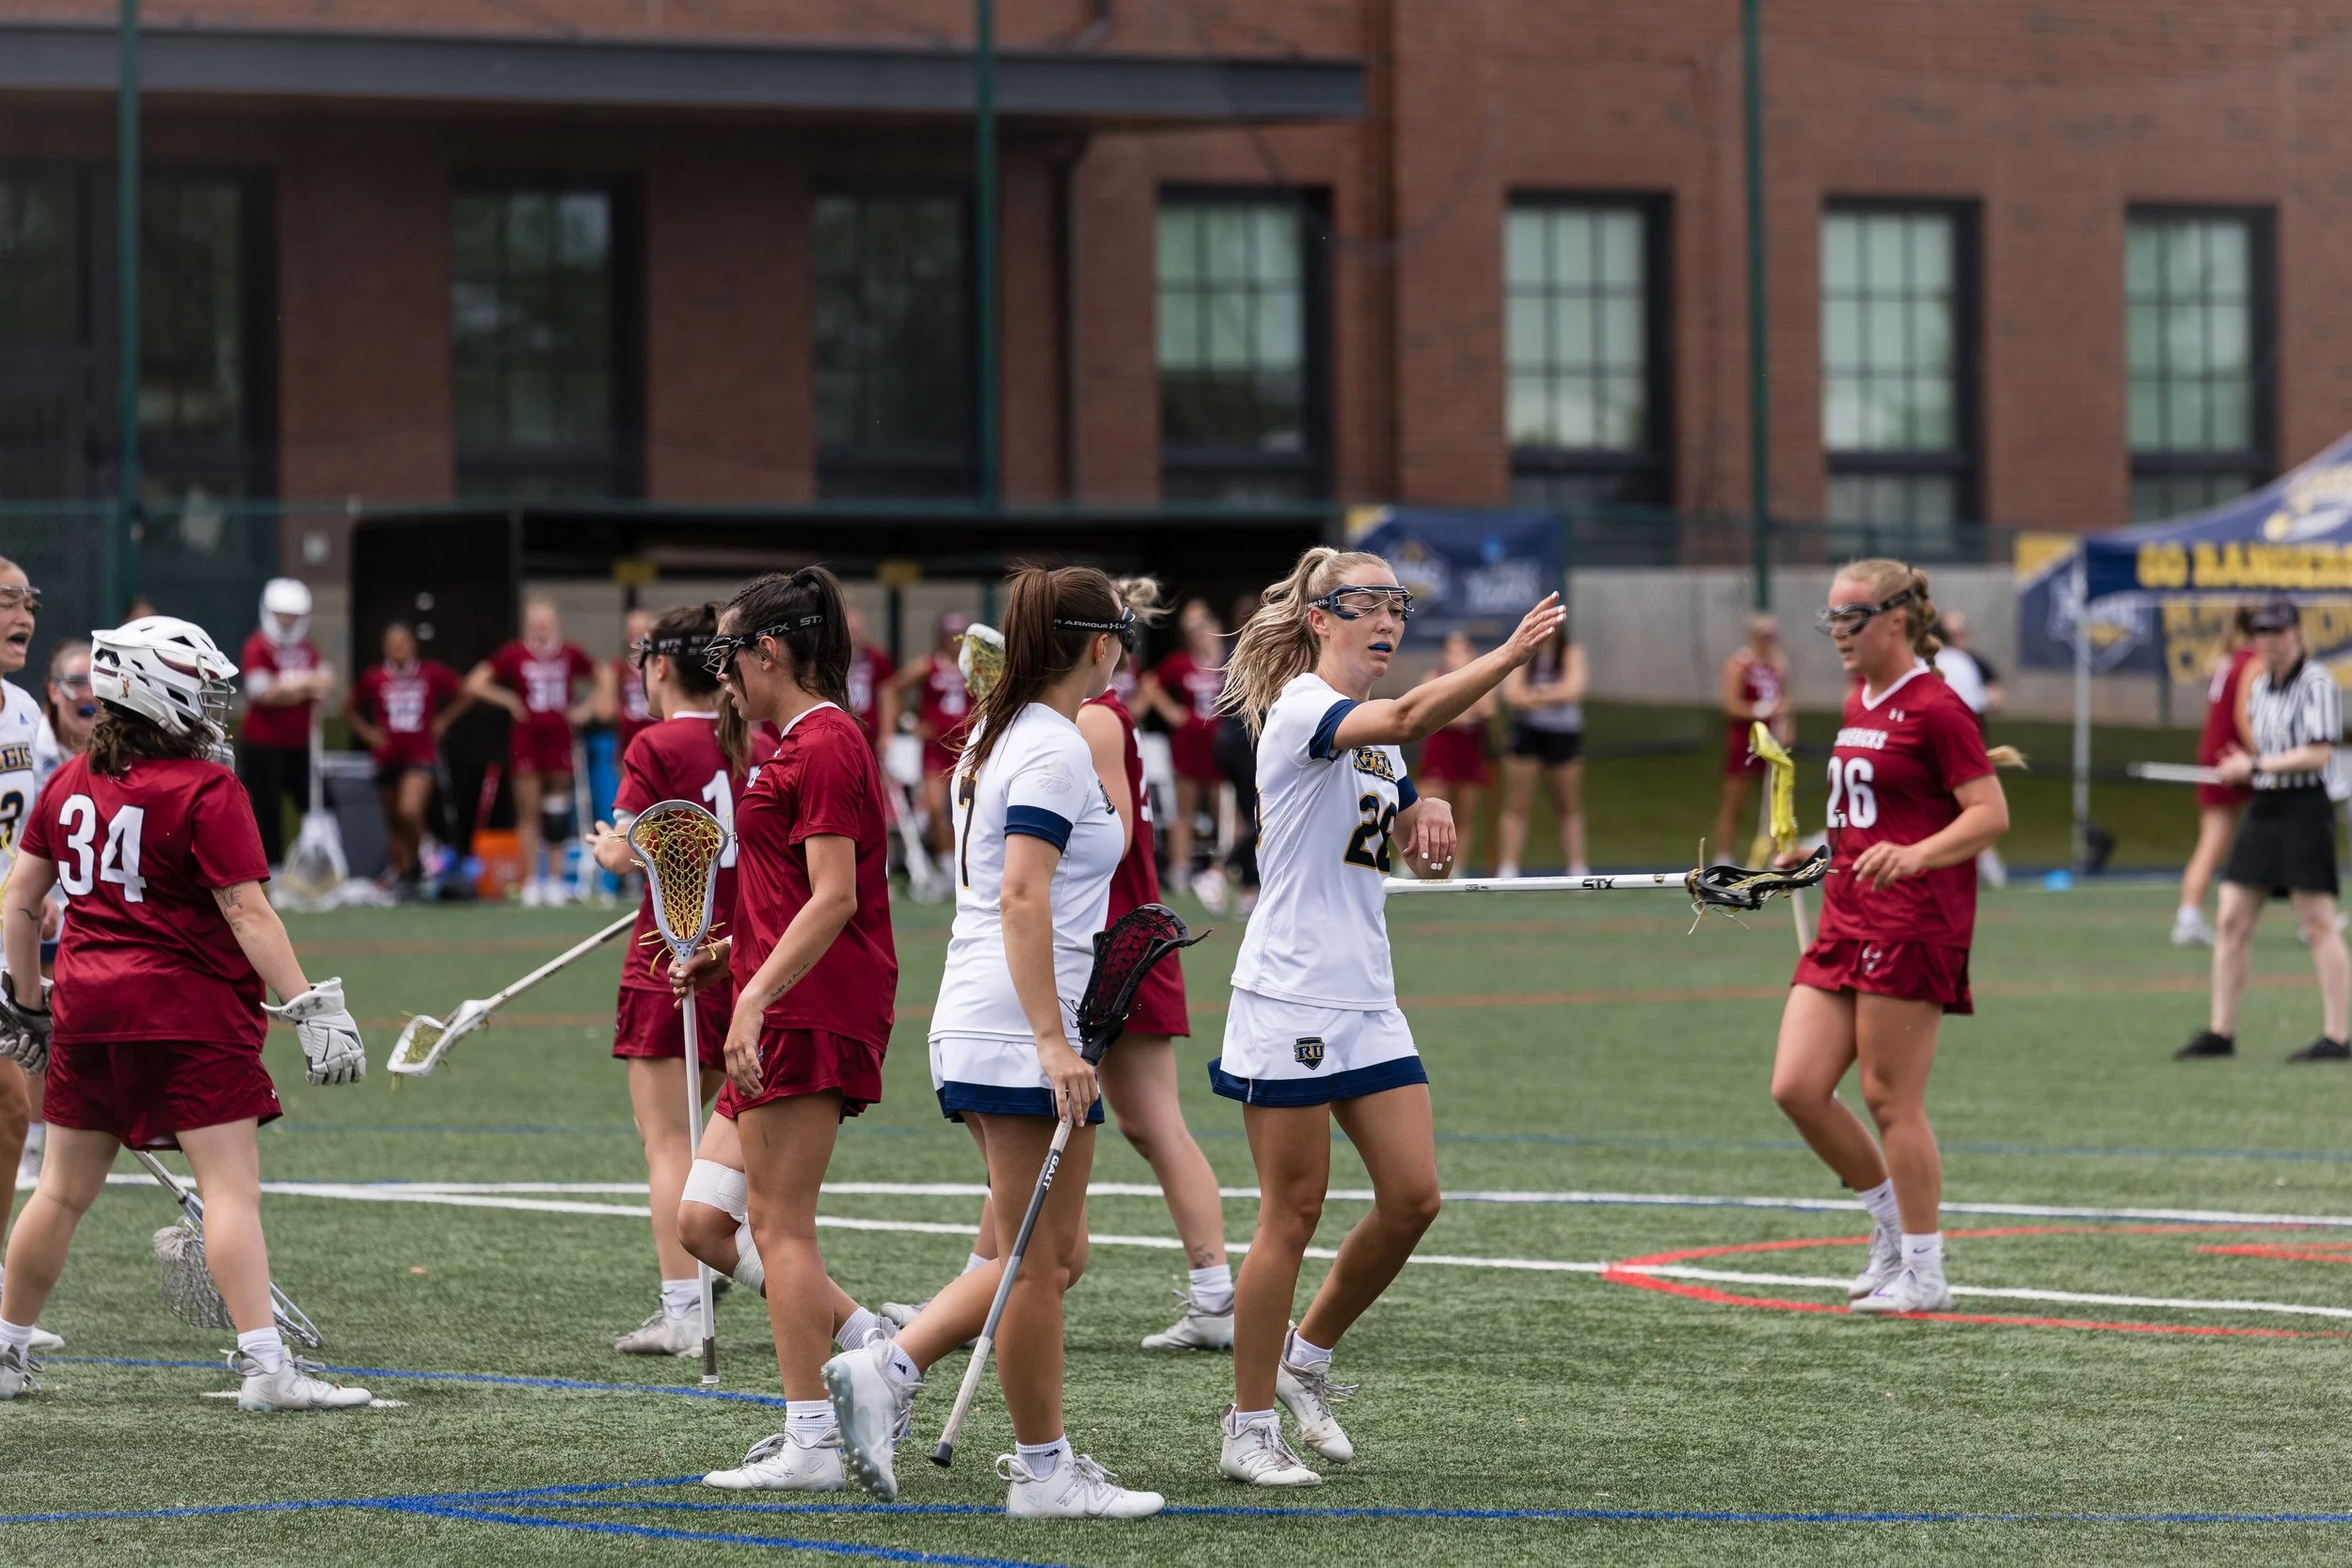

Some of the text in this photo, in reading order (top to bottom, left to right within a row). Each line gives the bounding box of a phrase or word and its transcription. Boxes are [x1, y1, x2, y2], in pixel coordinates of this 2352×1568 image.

[755, 622, 790, 641] STX
[1064, 619, 1108, 629] ARMOUR
[0, 742, 33, 773] GIS
[1826, 755, 1878, 829] 26
[57, 793, 148, 903] 34
[1581, 877, 1616, 891] STX
[1294, 1042, 1326, 1062] RU
[1041, 1154, 1060, 1192] GAIT
